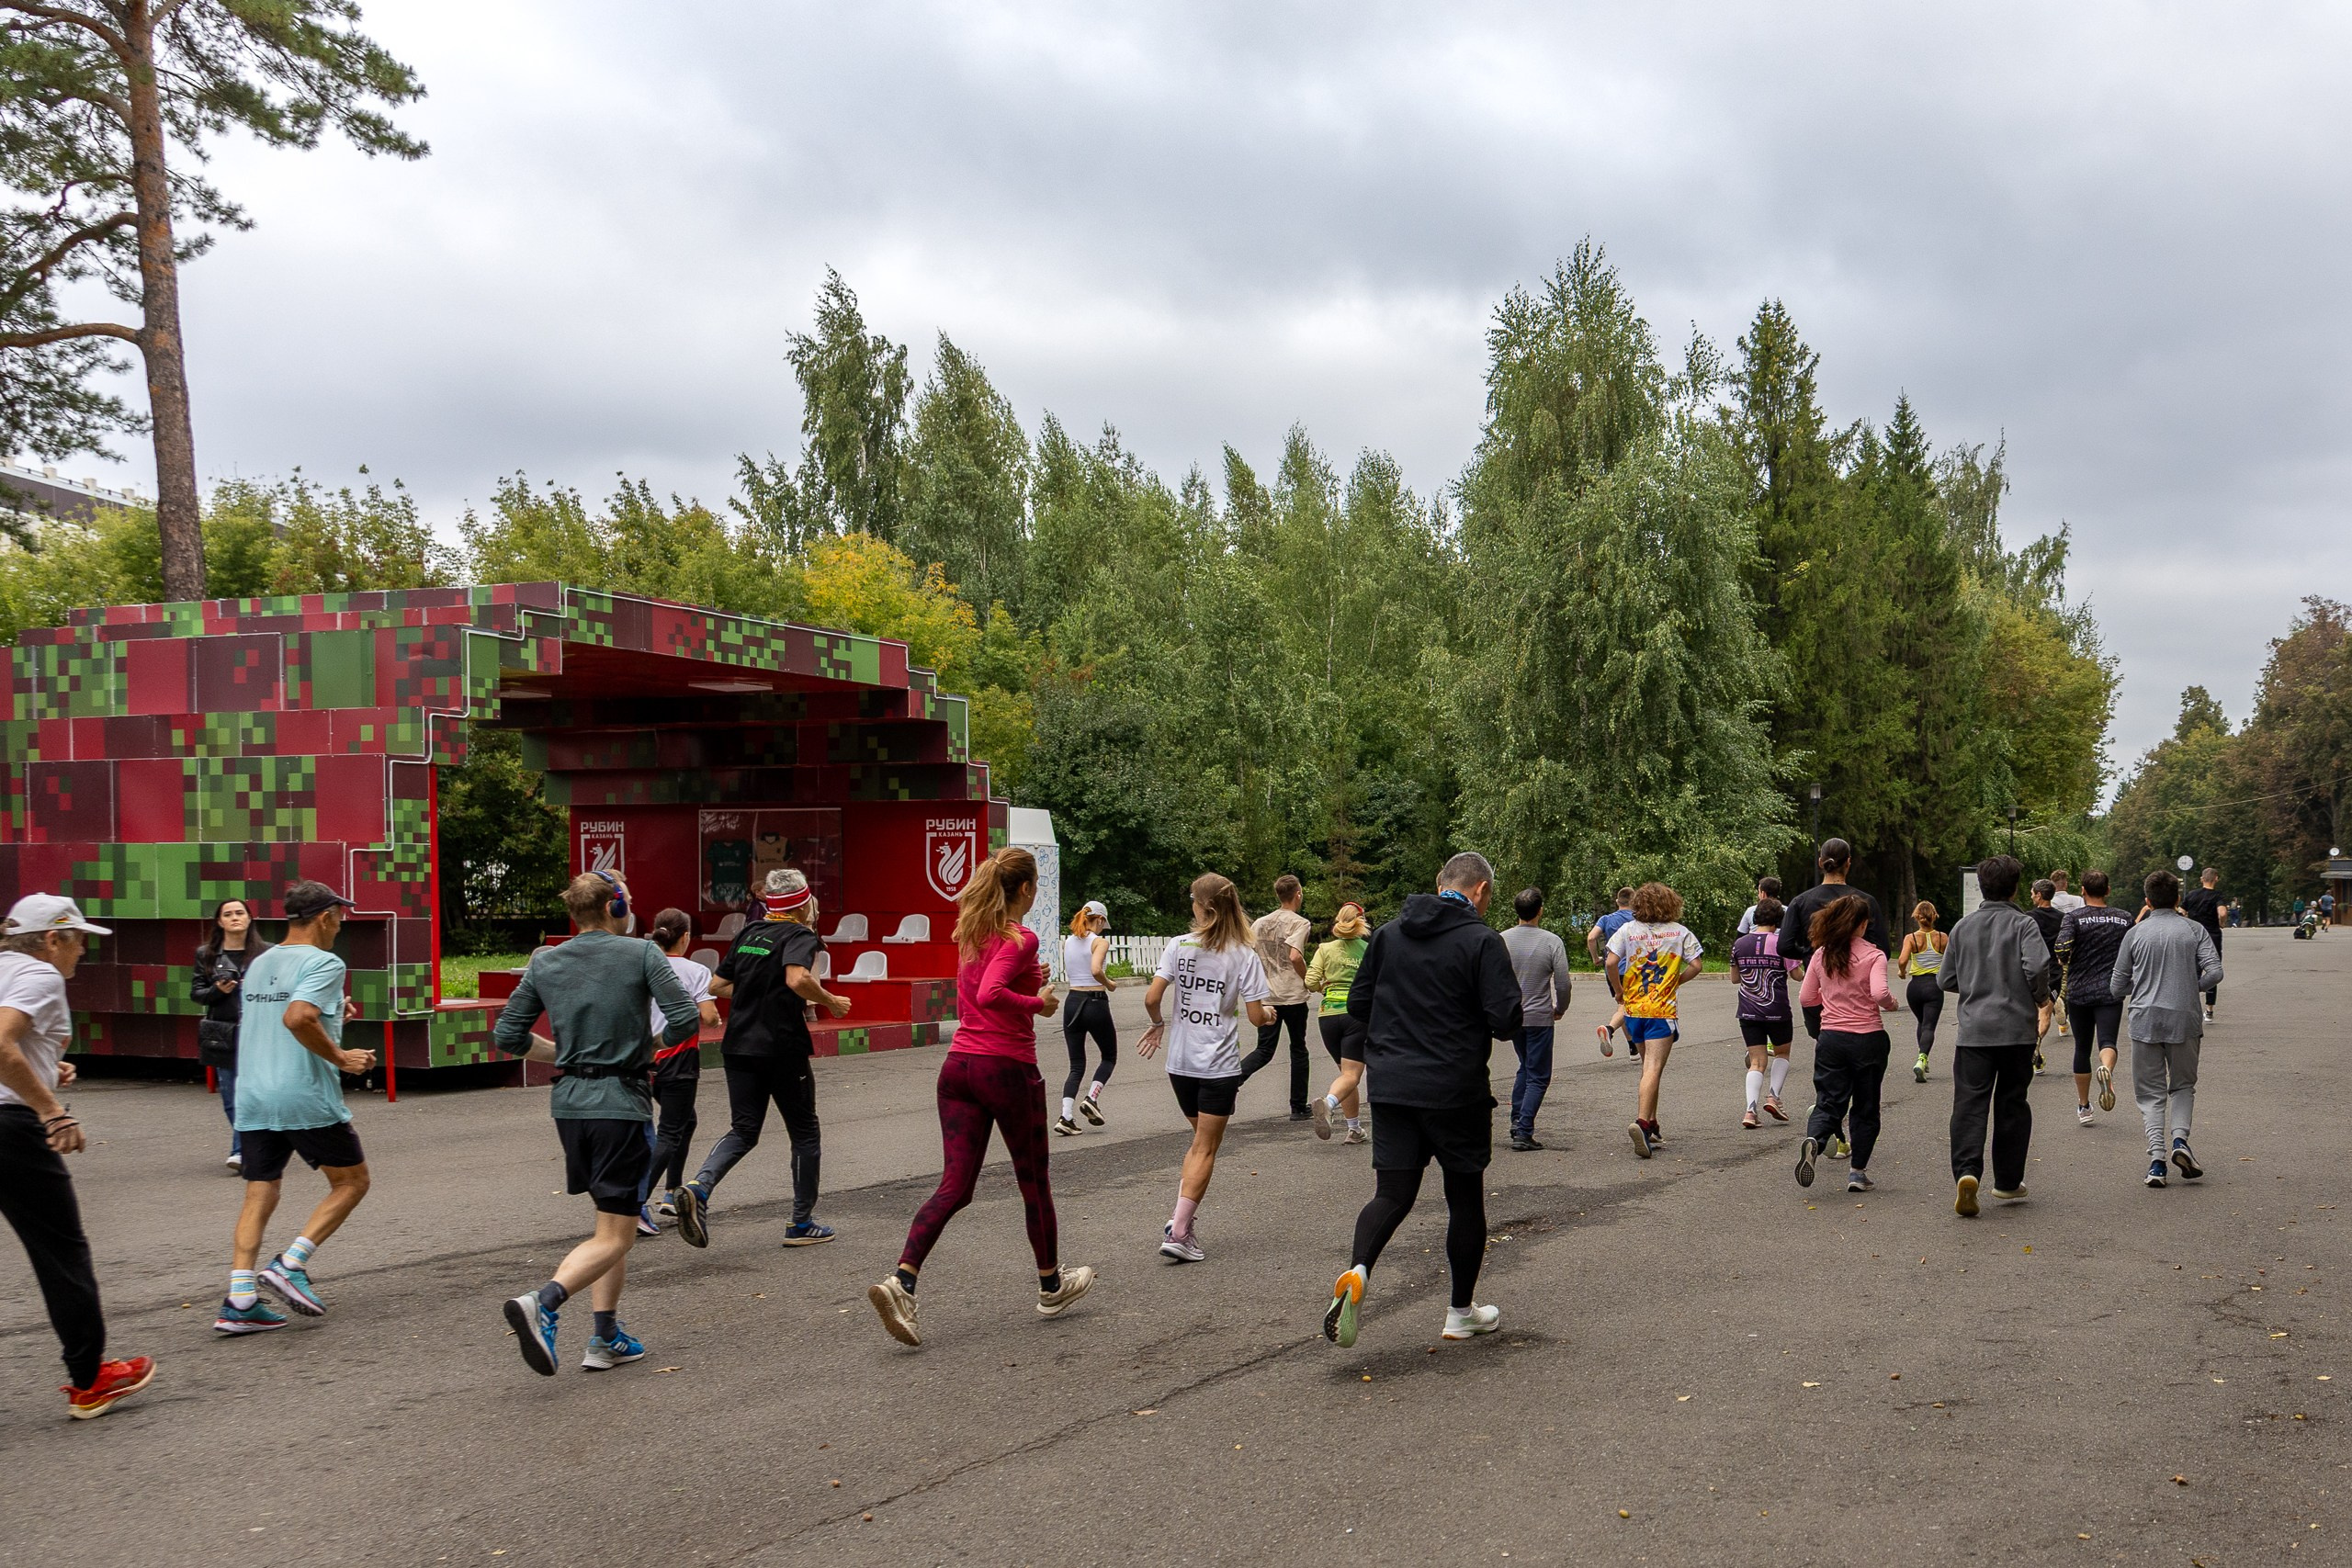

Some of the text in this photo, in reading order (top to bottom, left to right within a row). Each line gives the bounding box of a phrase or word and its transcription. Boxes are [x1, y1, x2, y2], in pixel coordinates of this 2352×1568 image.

[580, 821, 625, 833] РУБИН
[925, 818, 977, 830] РУБИН
[2078, 916, 2128, 927] FINISHER
[1178, 958, 1196, 974] BE
